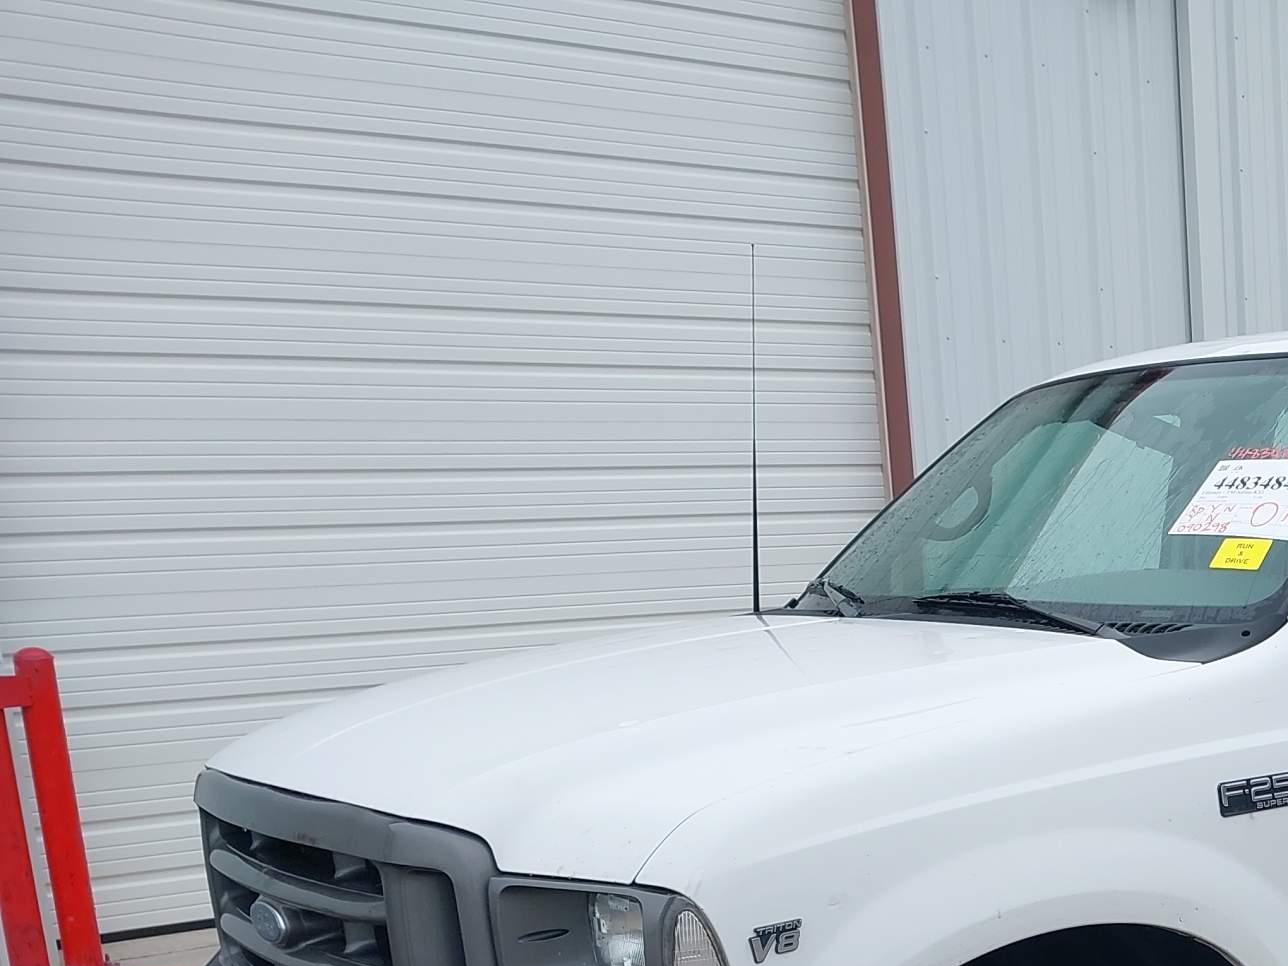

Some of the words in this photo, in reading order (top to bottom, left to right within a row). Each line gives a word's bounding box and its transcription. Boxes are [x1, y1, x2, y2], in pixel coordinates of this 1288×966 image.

[1225, 557, 1251, 565] DRIVE
[1256, 798, 1288, 809] SUPER
[756, 920, 801, 936] TRITON
[750, 930, 800, 963] V8
